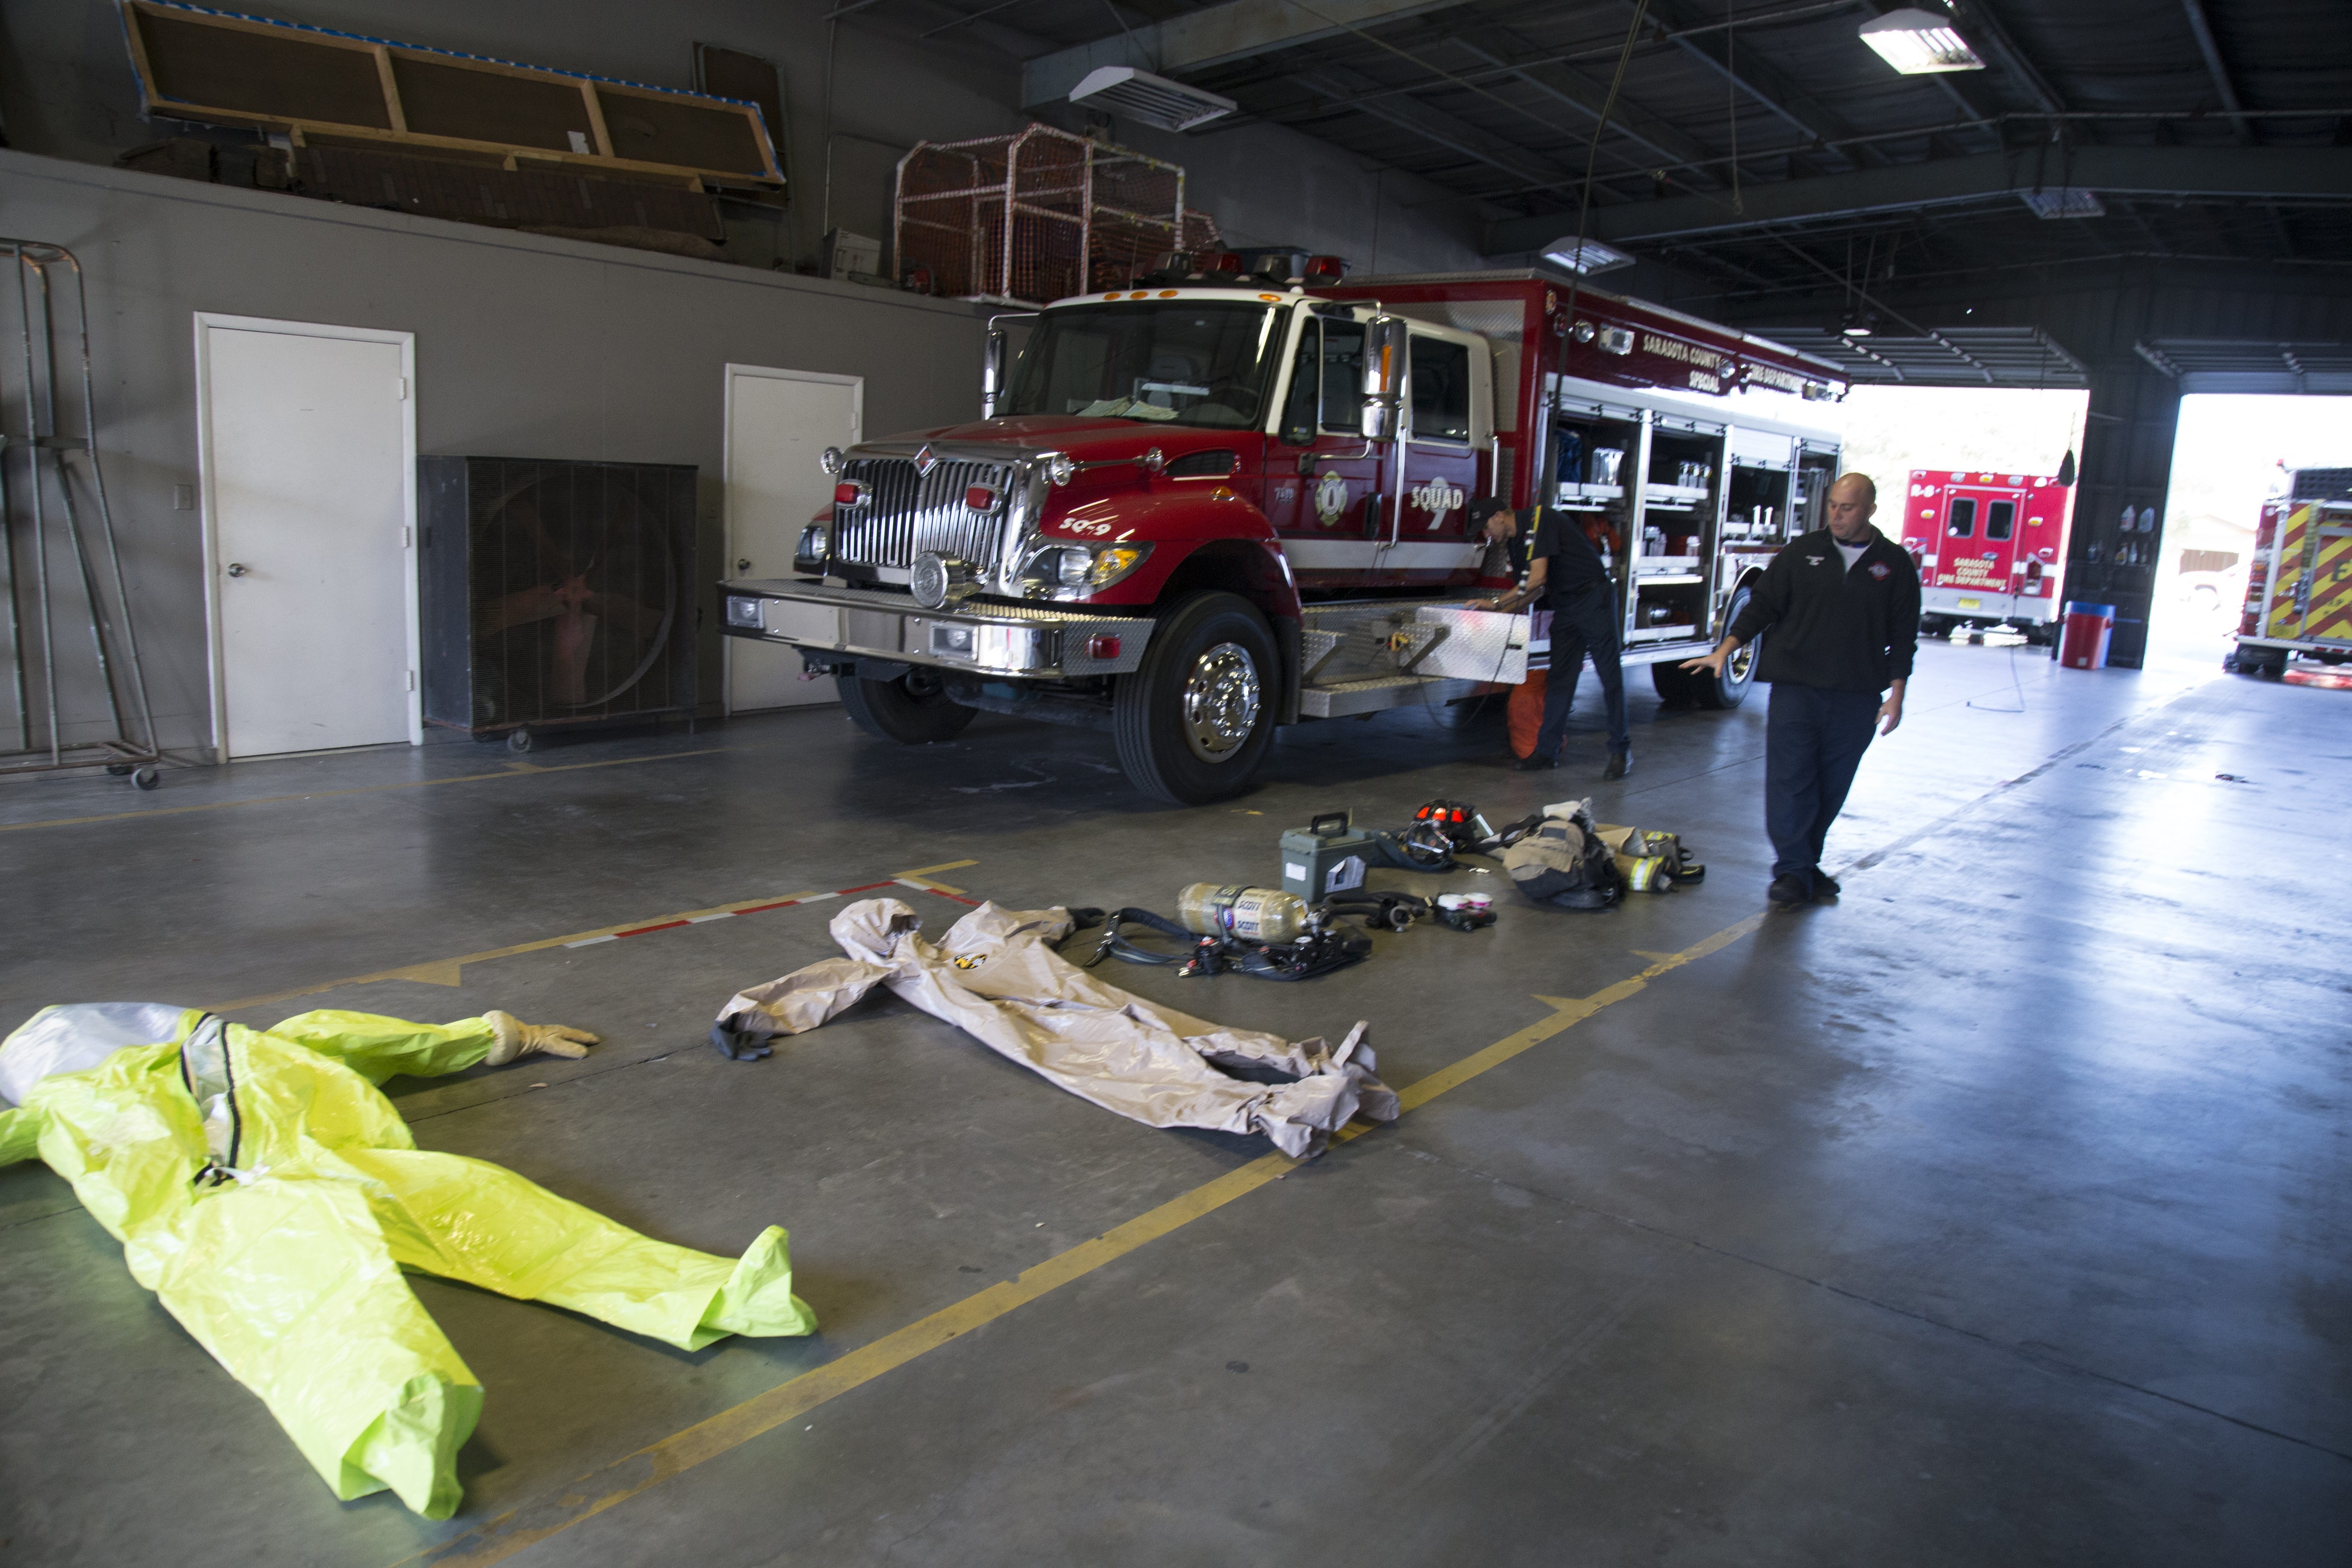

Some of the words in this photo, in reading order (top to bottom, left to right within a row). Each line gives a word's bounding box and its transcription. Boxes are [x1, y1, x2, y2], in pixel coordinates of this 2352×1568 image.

[1643, 334, 1689, 362] SARASOTA
[1689, 347, 1721, 370] COUNTY
[1689, 370, 1720, 393] SPECIAL
[1411, 486, 1464, 511] SQUAD
[1058, 518, 1112, 536] SQ-9
[1954, 557, 1994, 570] SARASOTA
[1937, 573, 1955, 584] FIRE
[1955, 576, 2007, 588] DEPARTMENT
[1957, 568, 1989, 578] COUNTY
[1237, 900, 1261, 911] SCOTT
[1237, 920, 1259, 931] SCOTT
